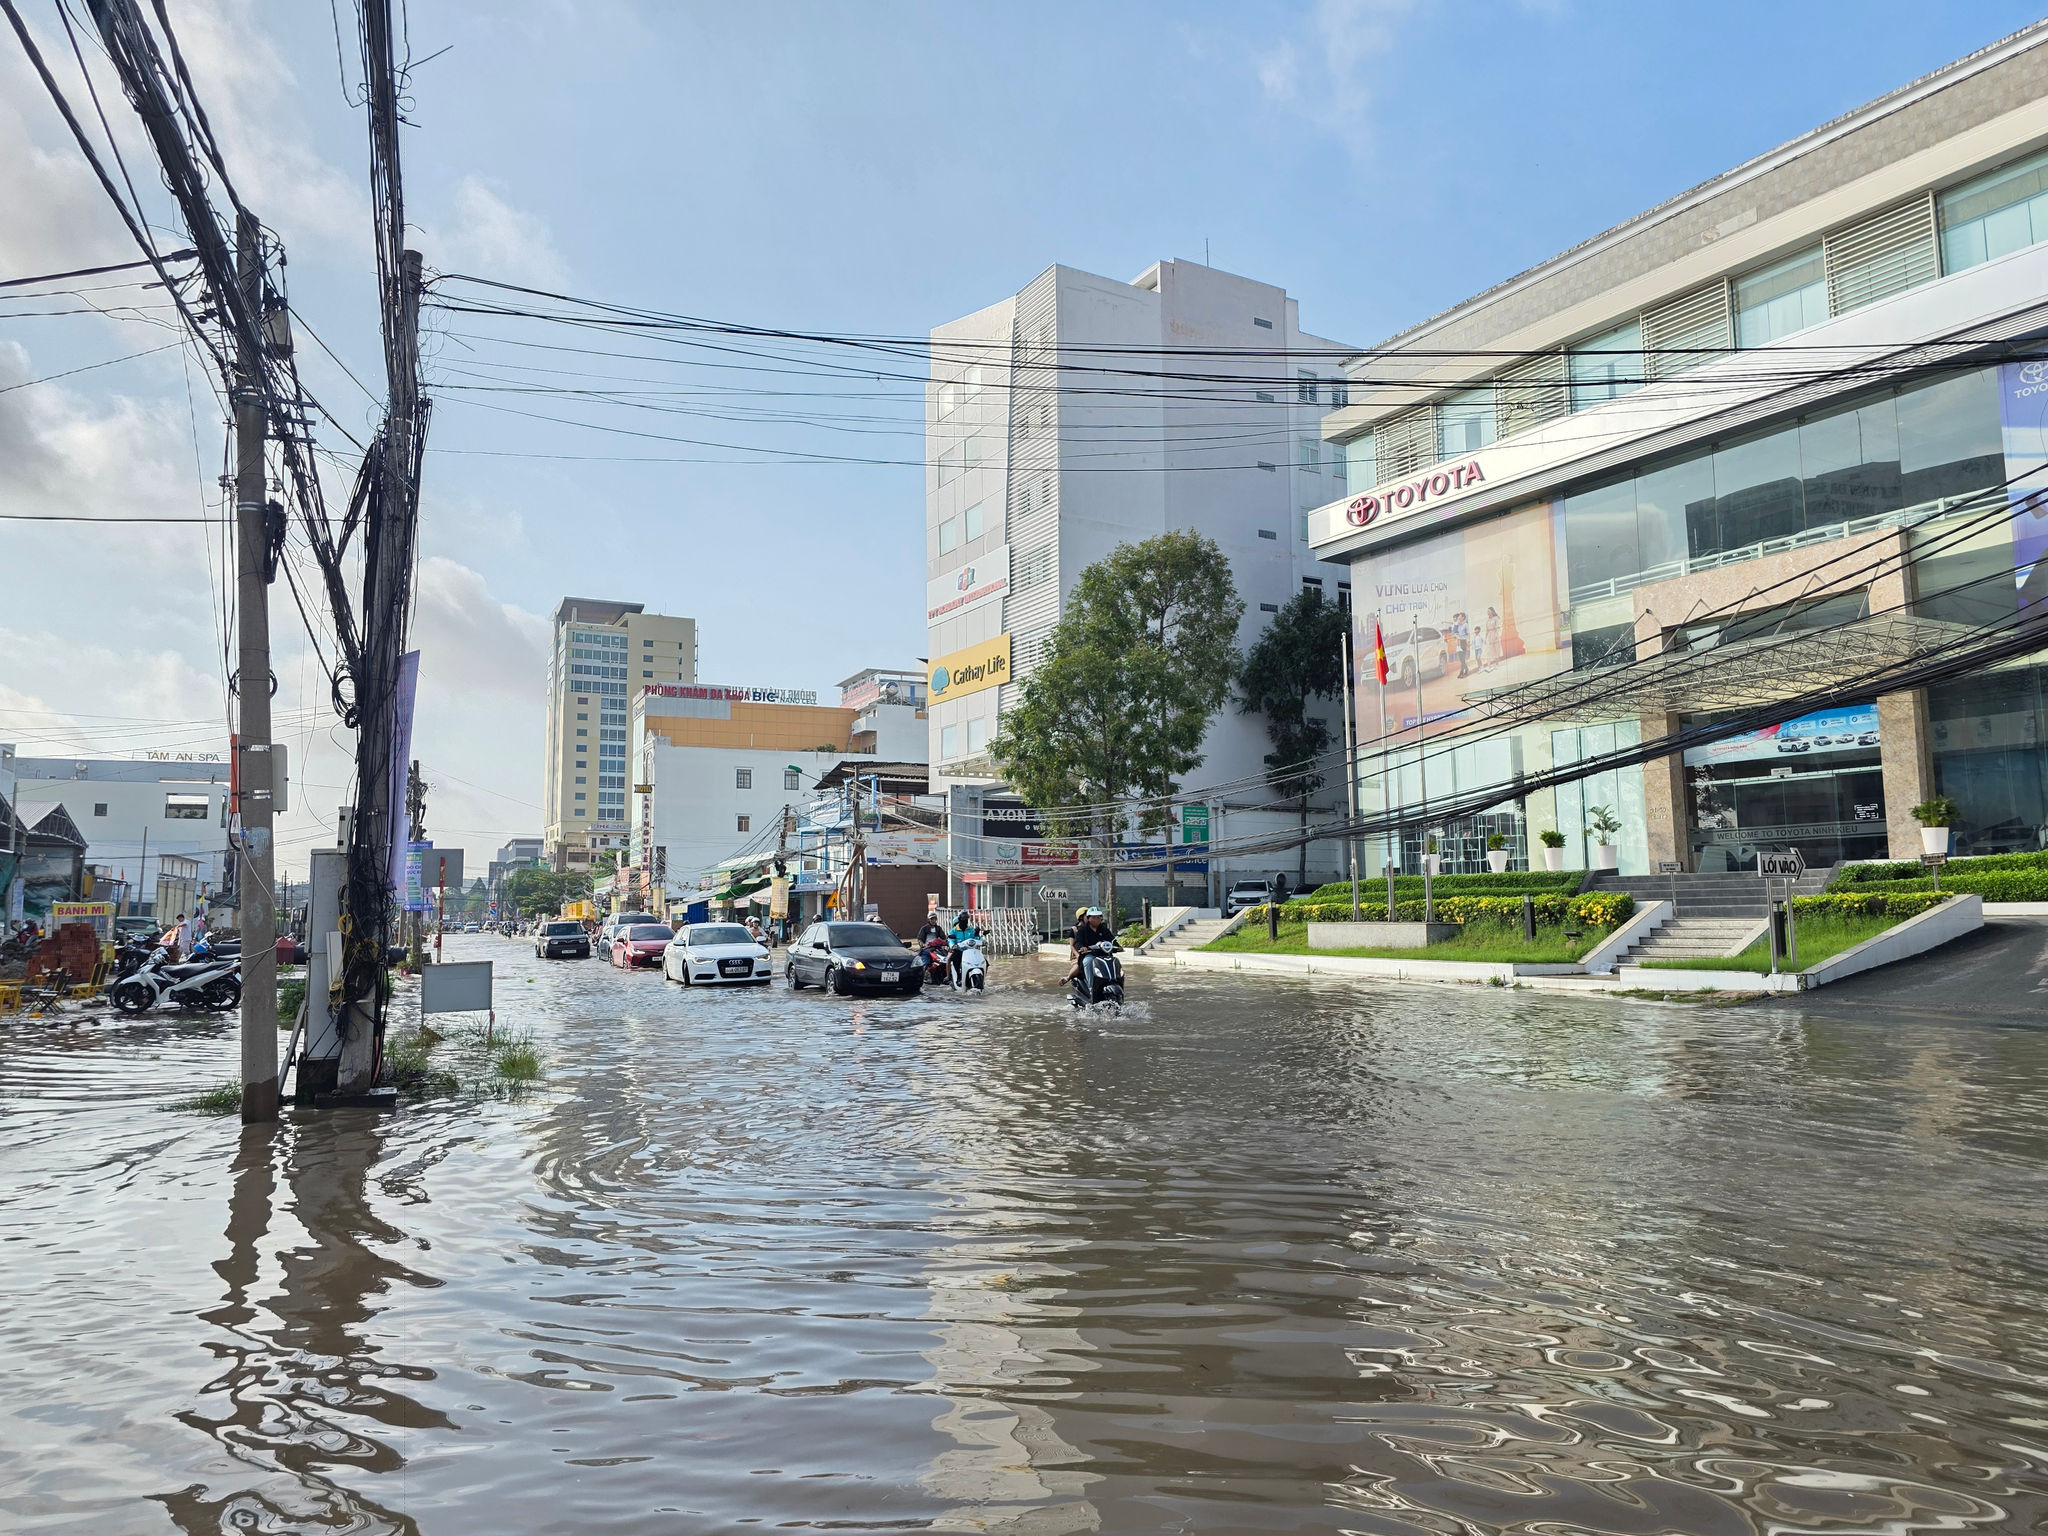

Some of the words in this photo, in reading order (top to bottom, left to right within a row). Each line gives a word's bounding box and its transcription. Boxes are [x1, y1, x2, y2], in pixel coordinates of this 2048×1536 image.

[1380, 460, 1486, 513] TOYOTA
[953, 663, 986, 686] Cathay
[987, 655, 1006, 675] Life
[146, 750, 170, 761] TÂM
[175, 752, 193, 761] AN
[198, 753, 220, 762] SPA
[986, 808, 1027, 821] AXON
[1717, 830, 1759, 840] WELCOME
[1762, 830, 1773, 838] TO
[1775, 828, 1811, 837] TOYOTA
[1812, 826, 1834, 835] NINH
[1763, 852, 1777, 873] LỐI
[1779, 857, 1796, 874] VÀO
[1046, 889, 1056, 898] LỐI
